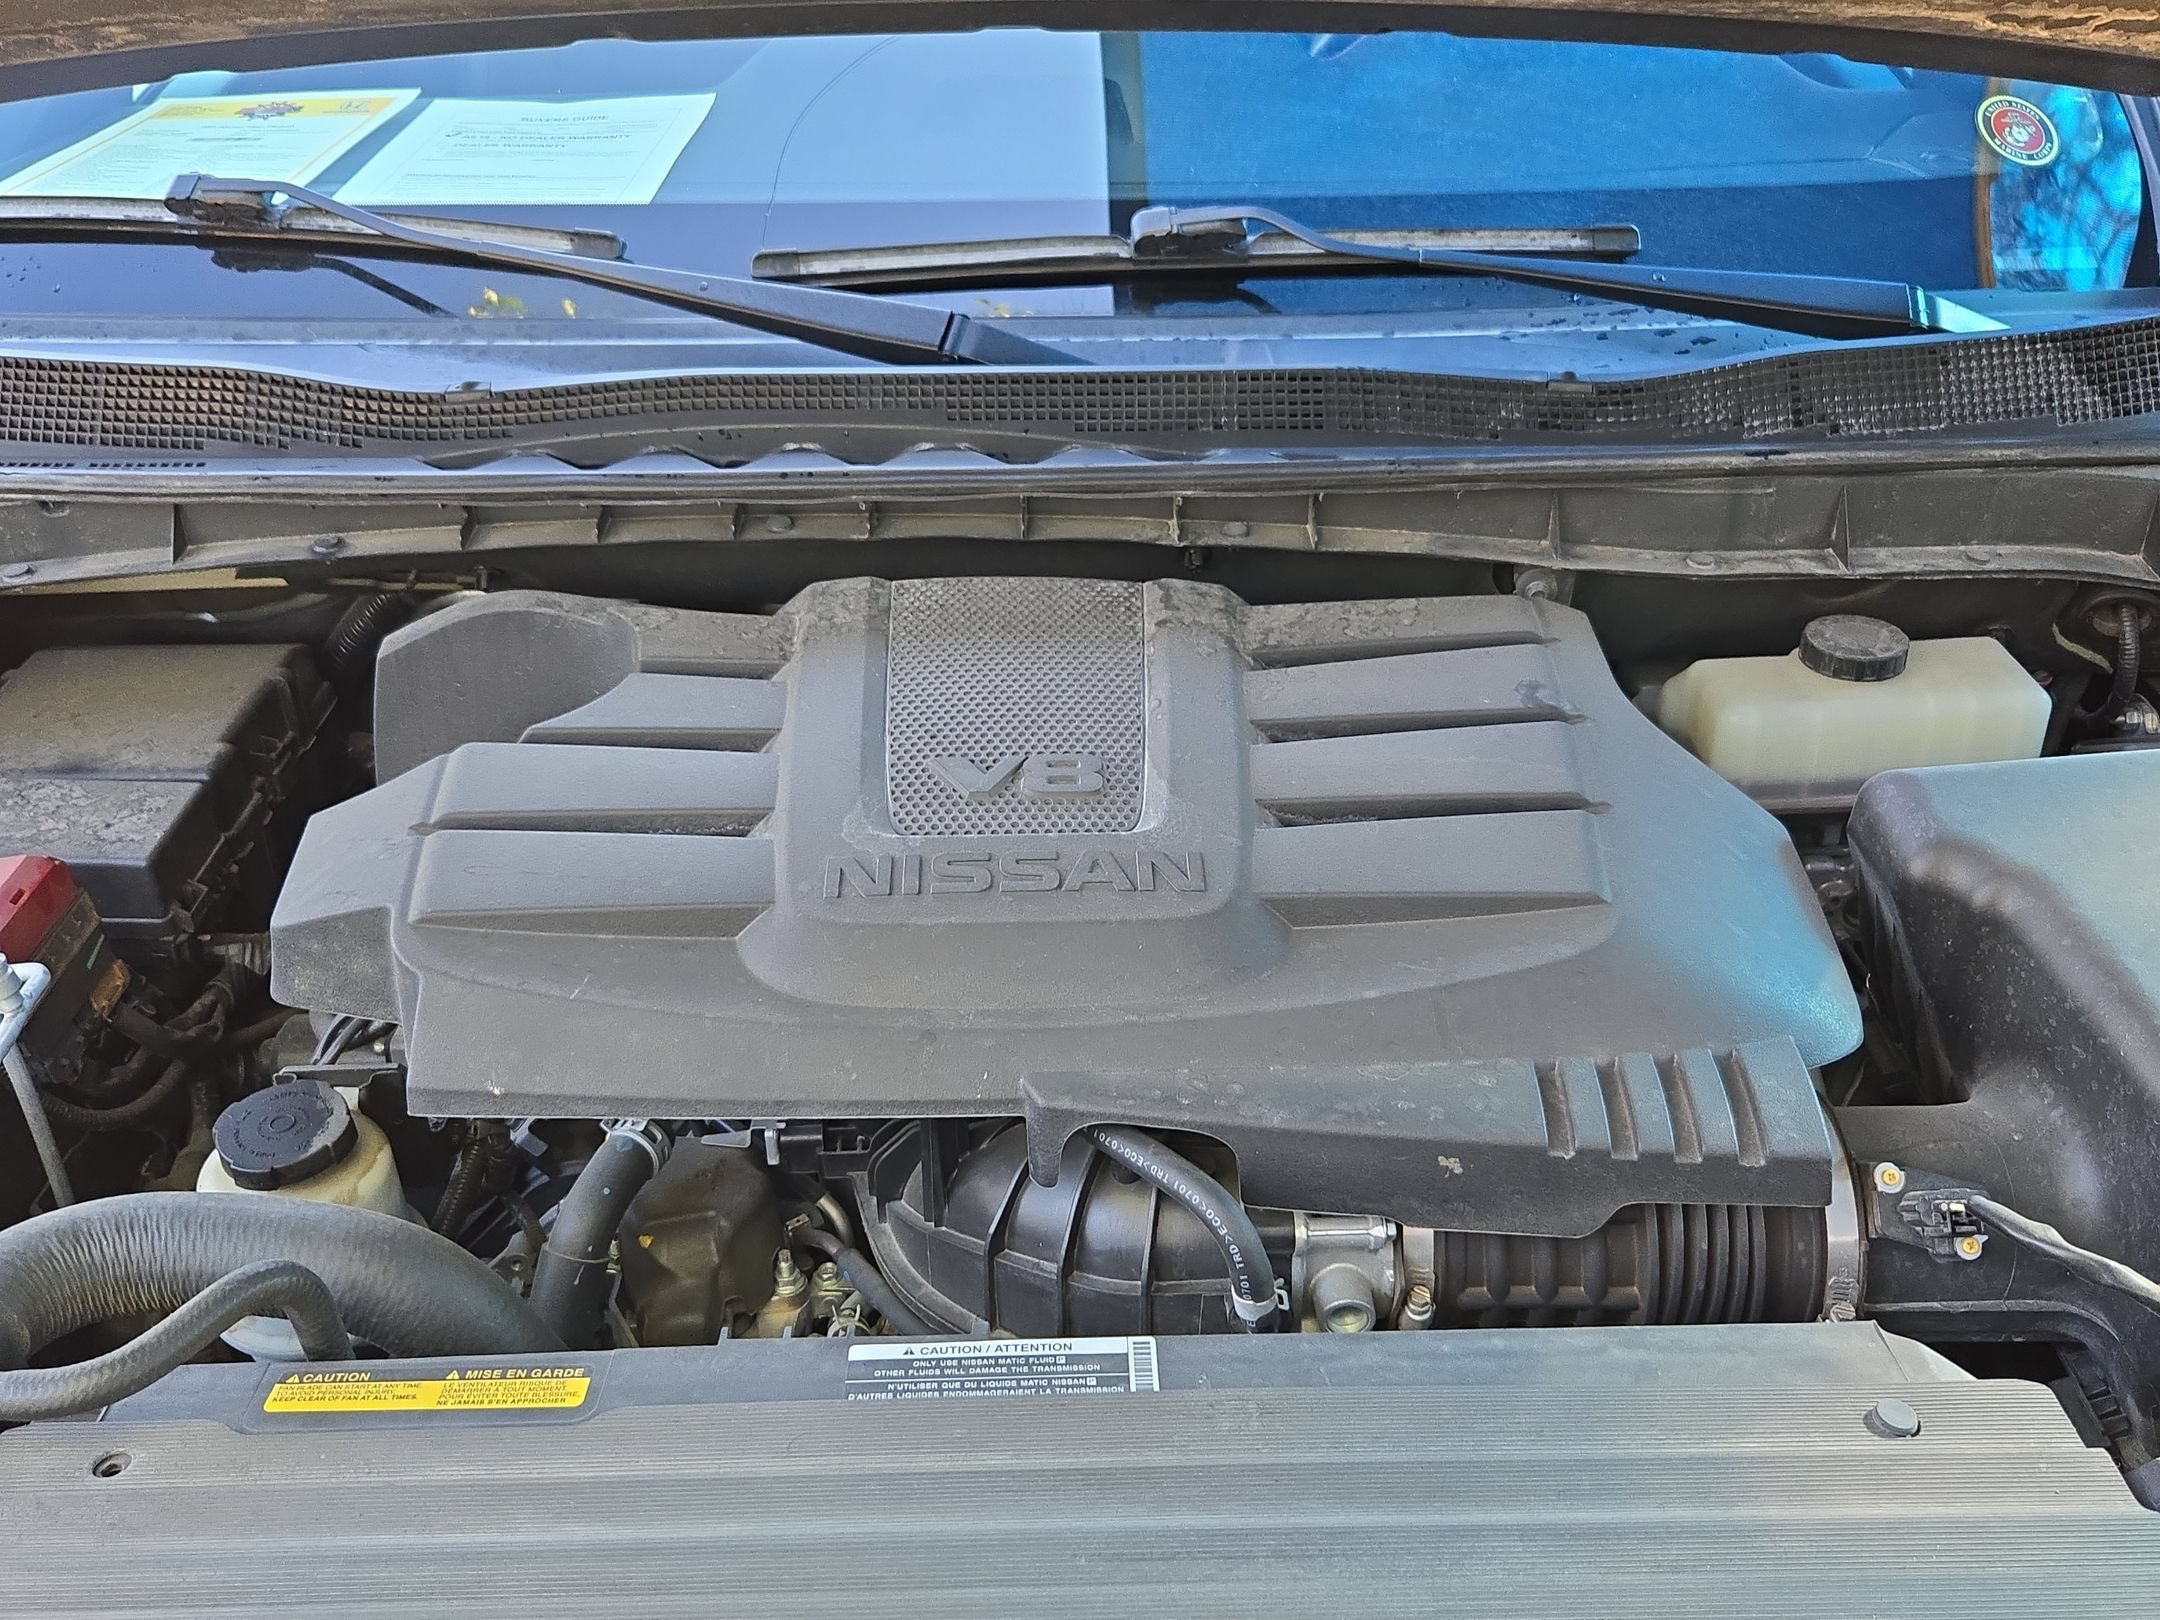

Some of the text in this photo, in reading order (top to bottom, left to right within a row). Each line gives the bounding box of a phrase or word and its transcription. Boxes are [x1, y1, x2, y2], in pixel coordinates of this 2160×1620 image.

[1984, 100, 2040, 120] UNITED STATES
[1994, 138, 2052, 160] MARINE CORPS
[928, 755, 1105, 800] V8
[822, 850, 1208, 898] NISSAN
[920, 1345, 982, 1355] CAUTION
[994, 1342, 1072, 1352] ATTENTION
[303, 1372, 370, 1382] CAUTION
[465, 1368, 585, 1379] MISE EN GARDE
[980, 1380, 1017, 1388] LIQUIDE
[1056, 1386, 1124, 1394] TRANSMISSION
